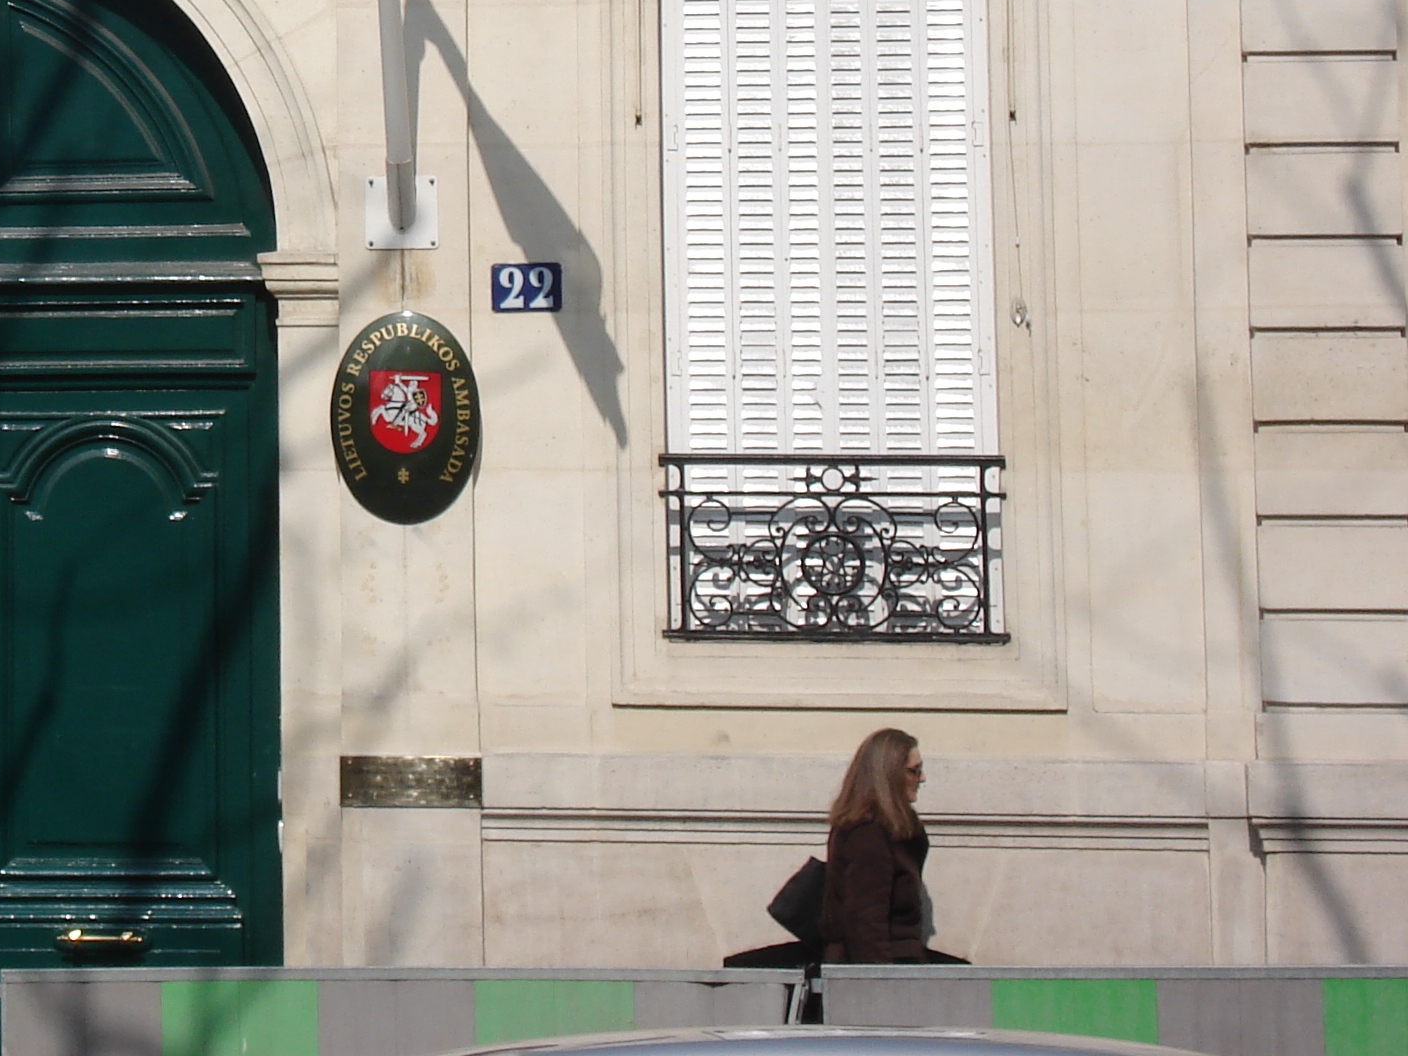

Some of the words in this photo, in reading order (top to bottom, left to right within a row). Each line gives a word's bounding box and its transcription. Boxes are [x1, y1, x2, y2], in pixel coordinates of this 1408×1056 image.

[499, 266, 554, 309] 22
[346, 322, 460, 377] RESPUBLIKOS
[338, 382, 368, 481] LIETUVOS
[439, 376, 471, 483] AMBASADA
